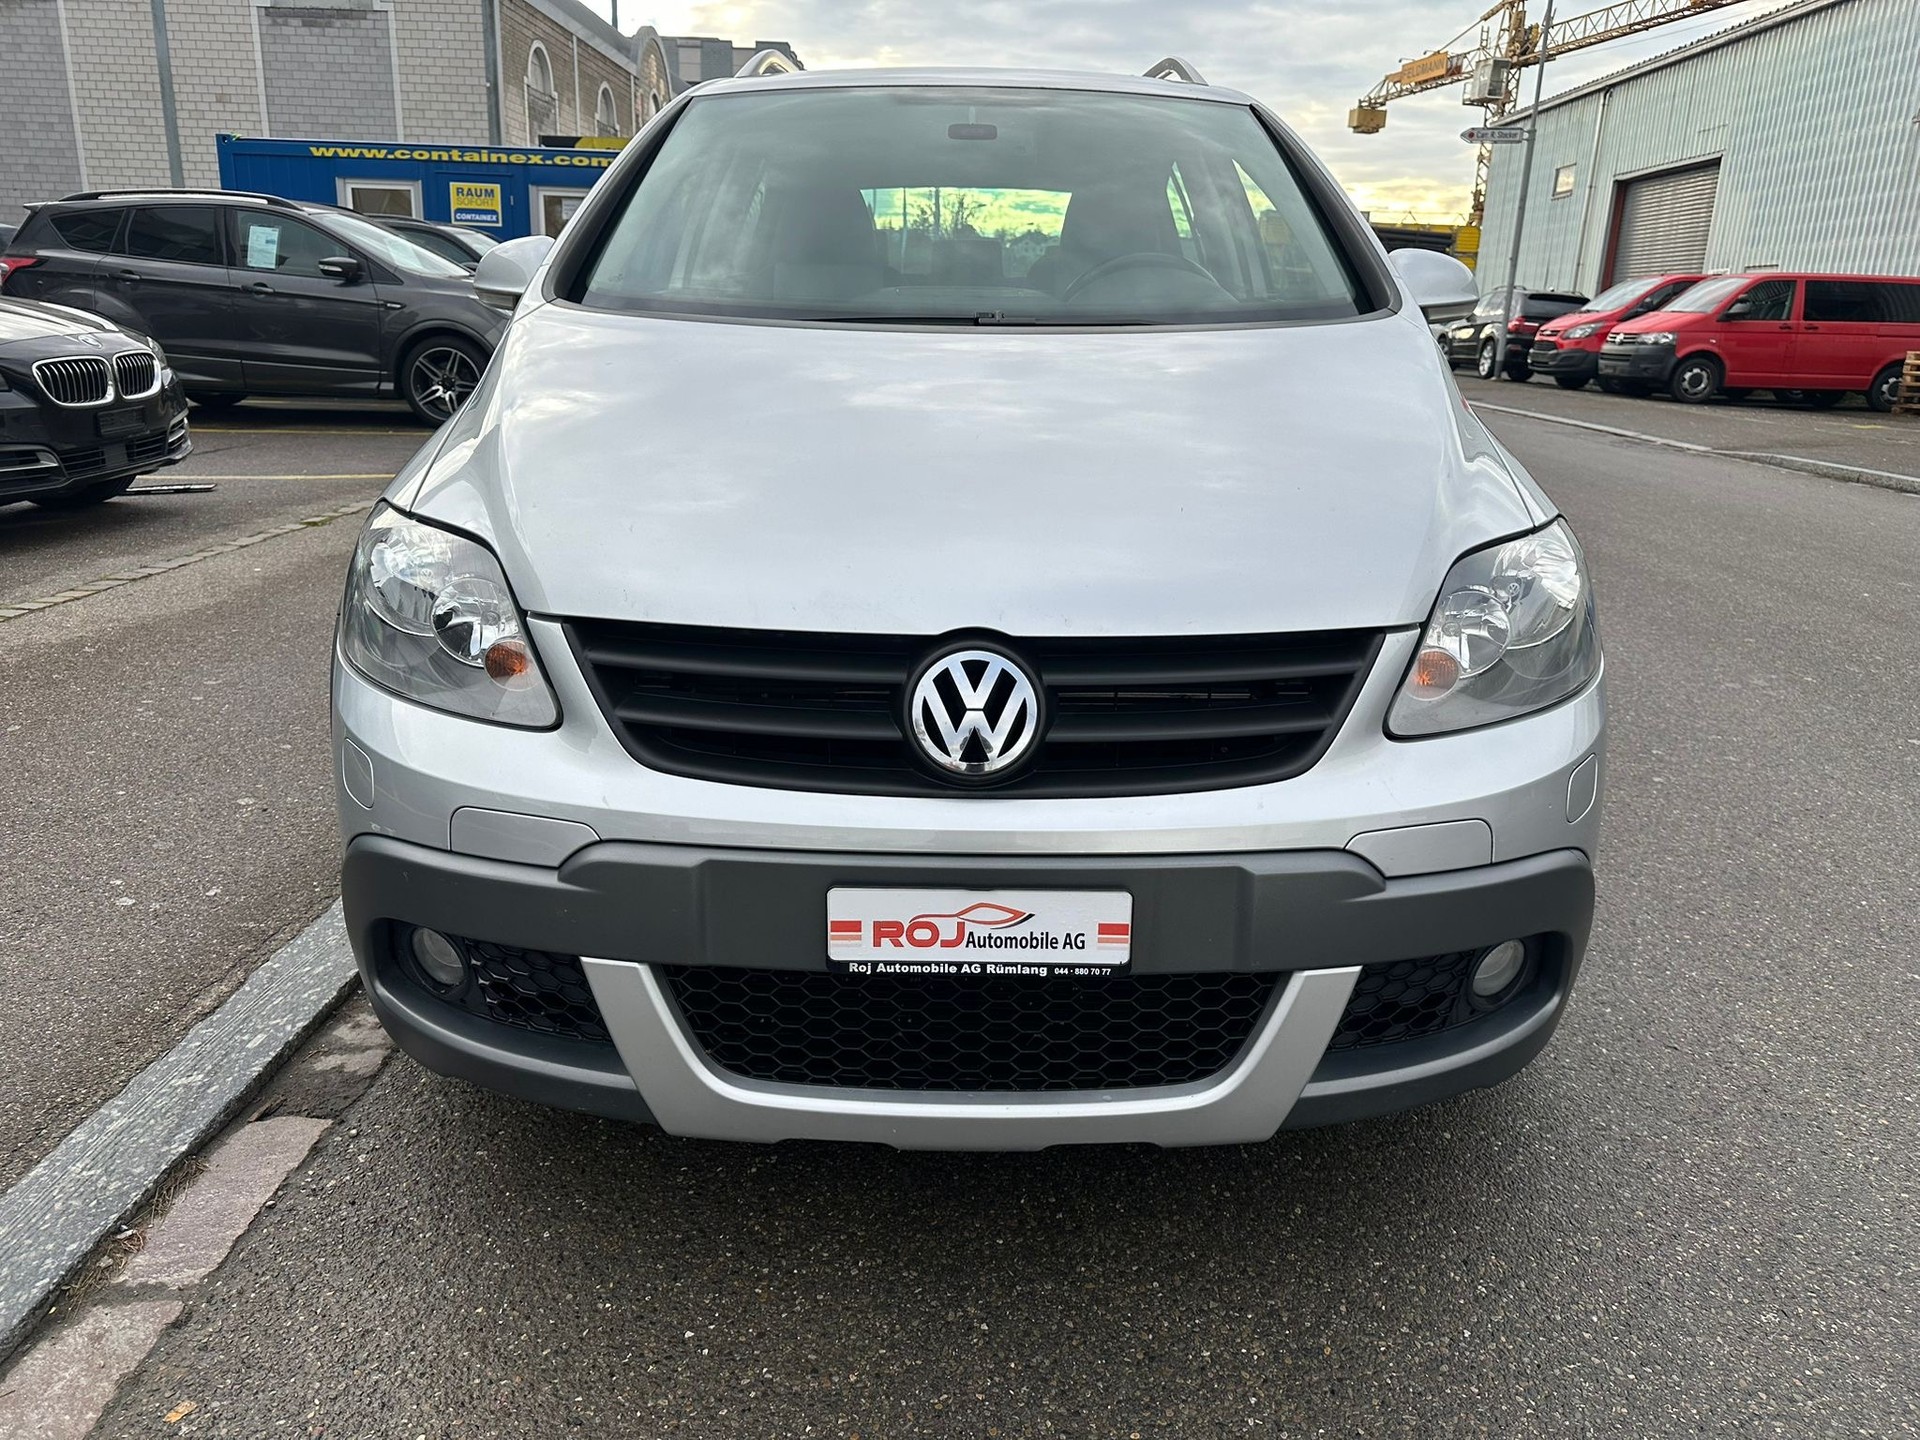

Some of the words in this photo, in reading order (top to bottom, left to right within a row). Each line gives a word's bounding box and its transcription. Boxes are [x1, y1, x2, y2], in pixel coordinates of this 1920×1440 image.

[309, 146, 615, 168] www.containex.com
[456, 187, 495, 198] RAUM
[456, 197, 495, 207] SOFORT
[455, 213, 498, 221] CONTAINEX
[912, 650, 1018, 772] VW
[873, 920, 966, 948] ROJ
[965, 930, 1059, 950] Automobile
[1062, 931, 1086, 950] AG
[848, 962, 872, 975] Roj
[876, 963, 958, 974] Automobile
[961, 963, 982, 974] AG
[986, 964, 1048, 977] Rümlang
[1054, 967, 1069, 975] 044
[1074, 967, 1089, 976] 880
[1090, 968, 1100, 976] 70
[1101, 968, 1112, 976] 77
